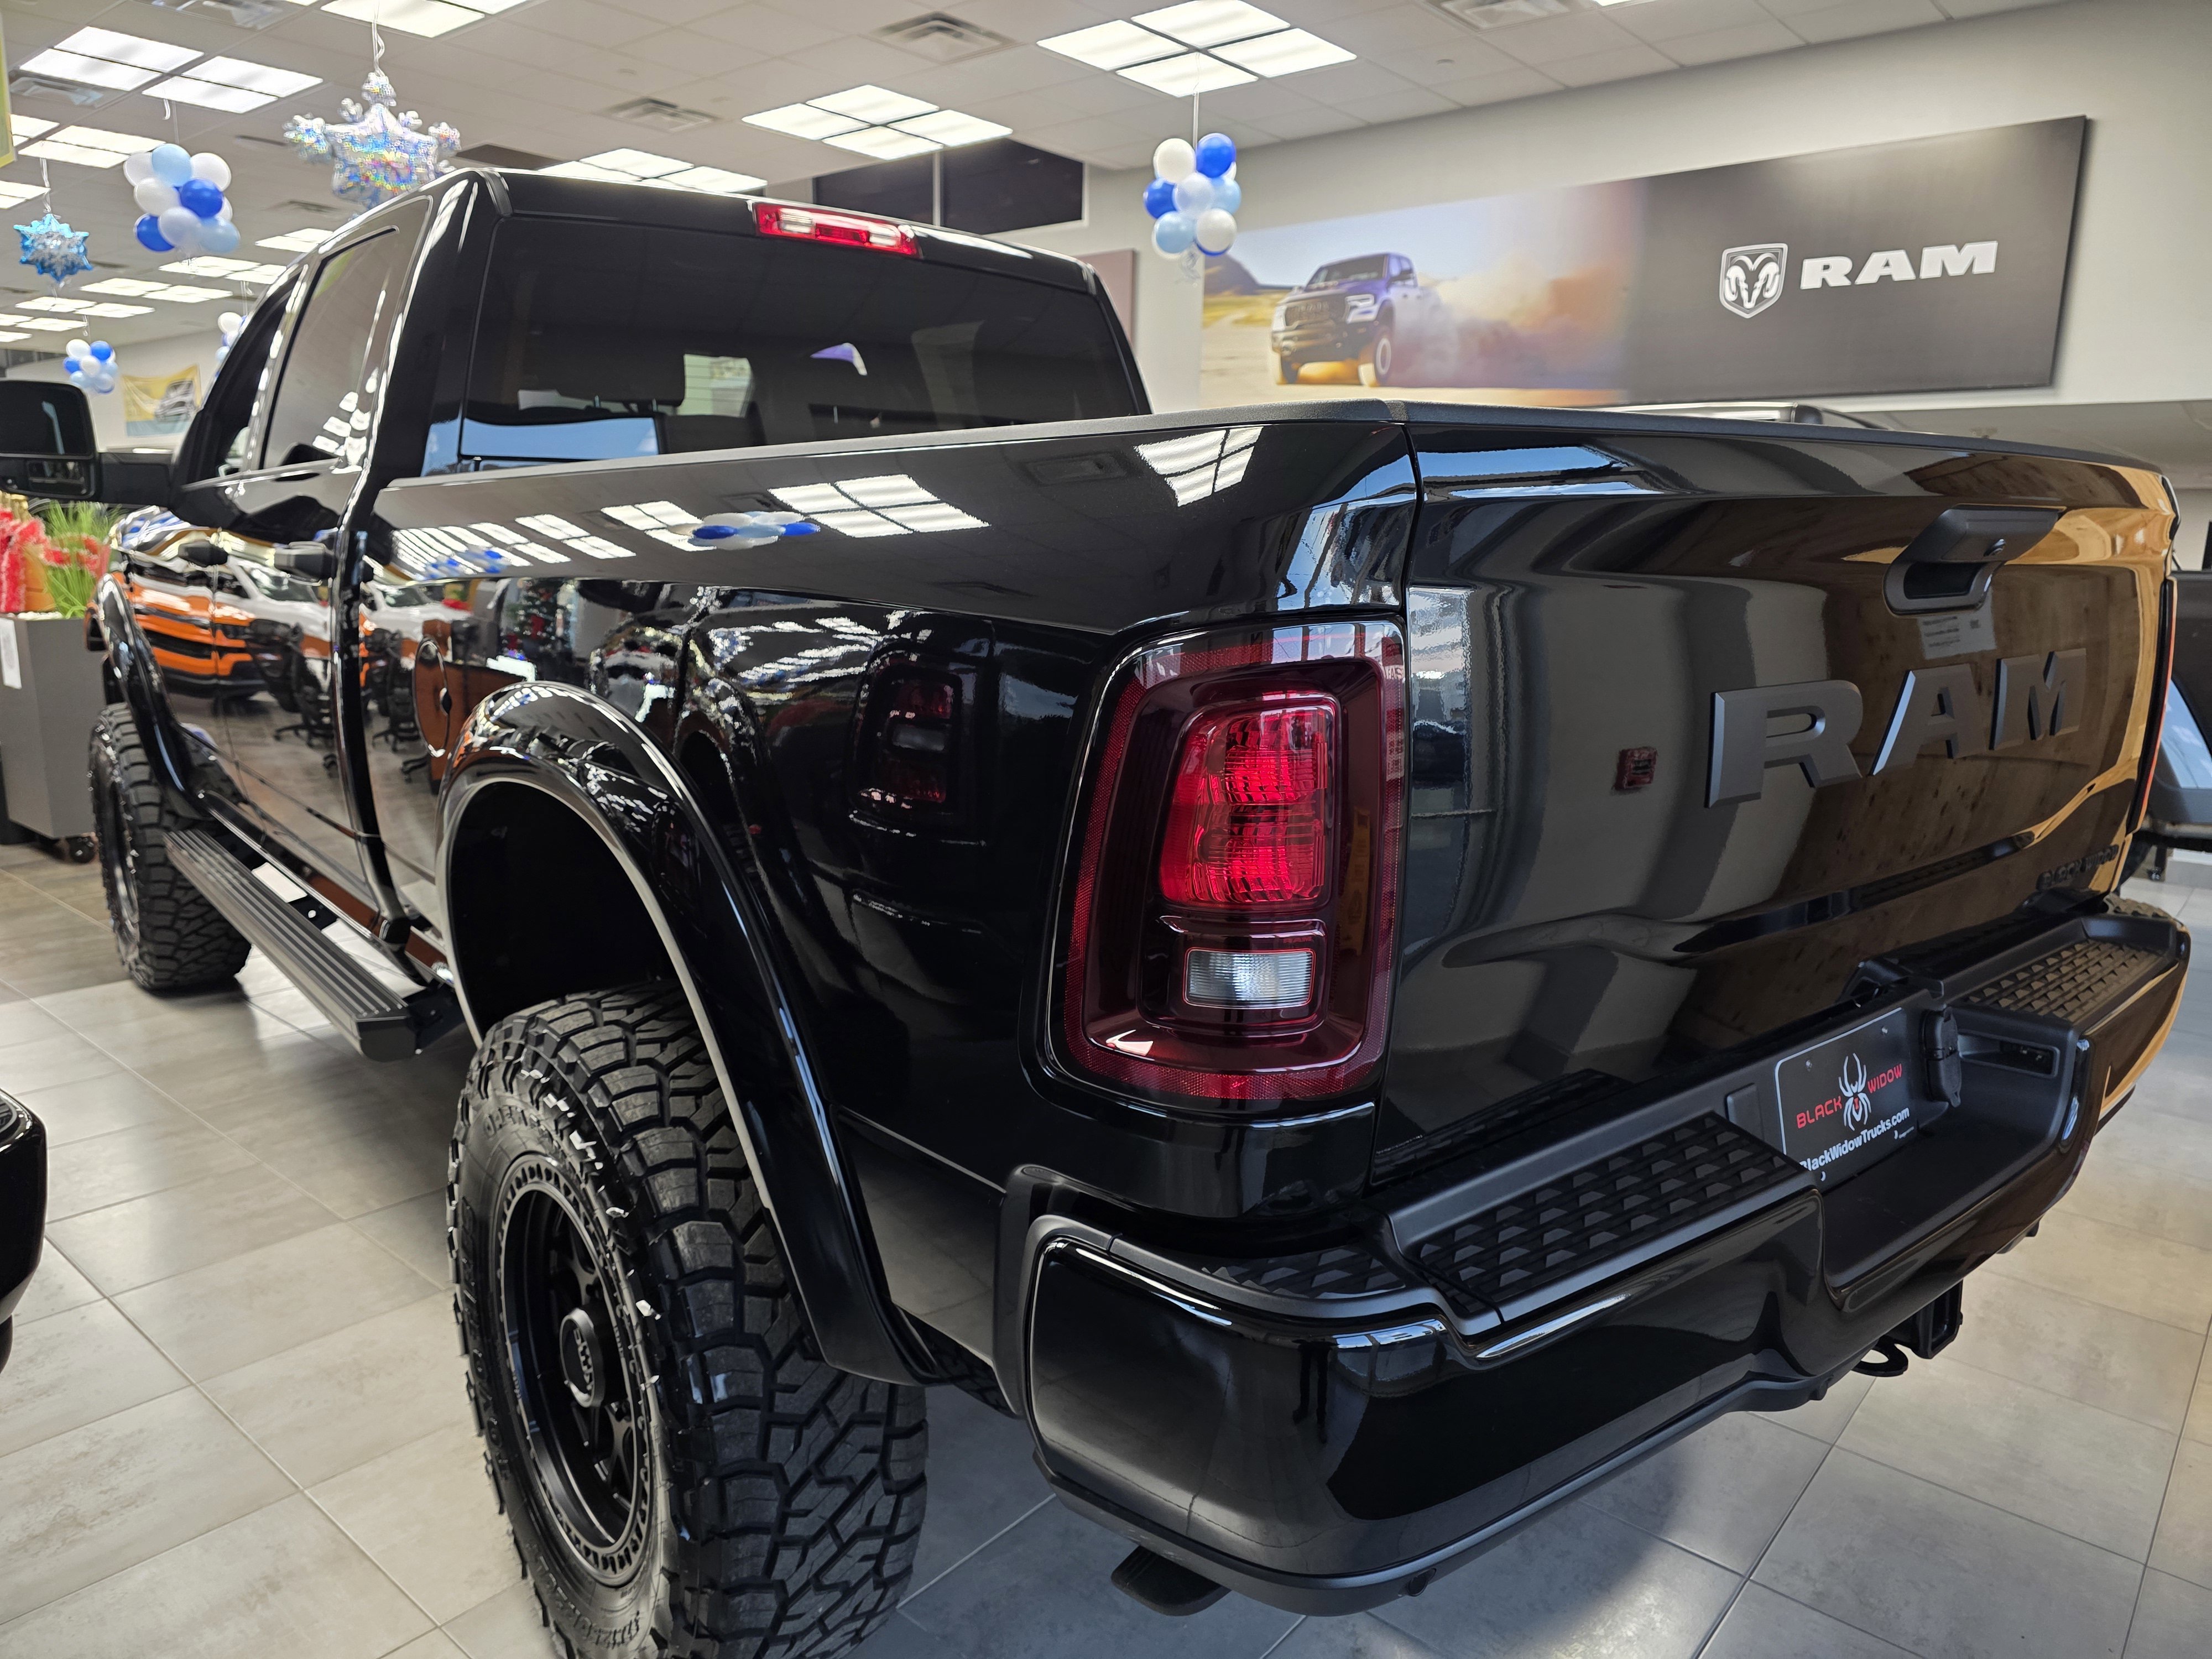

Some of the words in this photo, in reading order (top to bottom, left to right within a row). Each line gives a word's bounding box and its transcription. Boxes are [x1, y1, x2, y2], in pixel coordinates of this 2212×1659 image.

[1801, 241, 1998, 289] RAM
[1705, 648, 2087, 808] RAM
[1797, 1095, 1843, 1129] BLACK
[1867, 1063, 1903, 1094] WIDOW
[1799, 1107, 1910, 1171] BlackWidowTrucks.com
